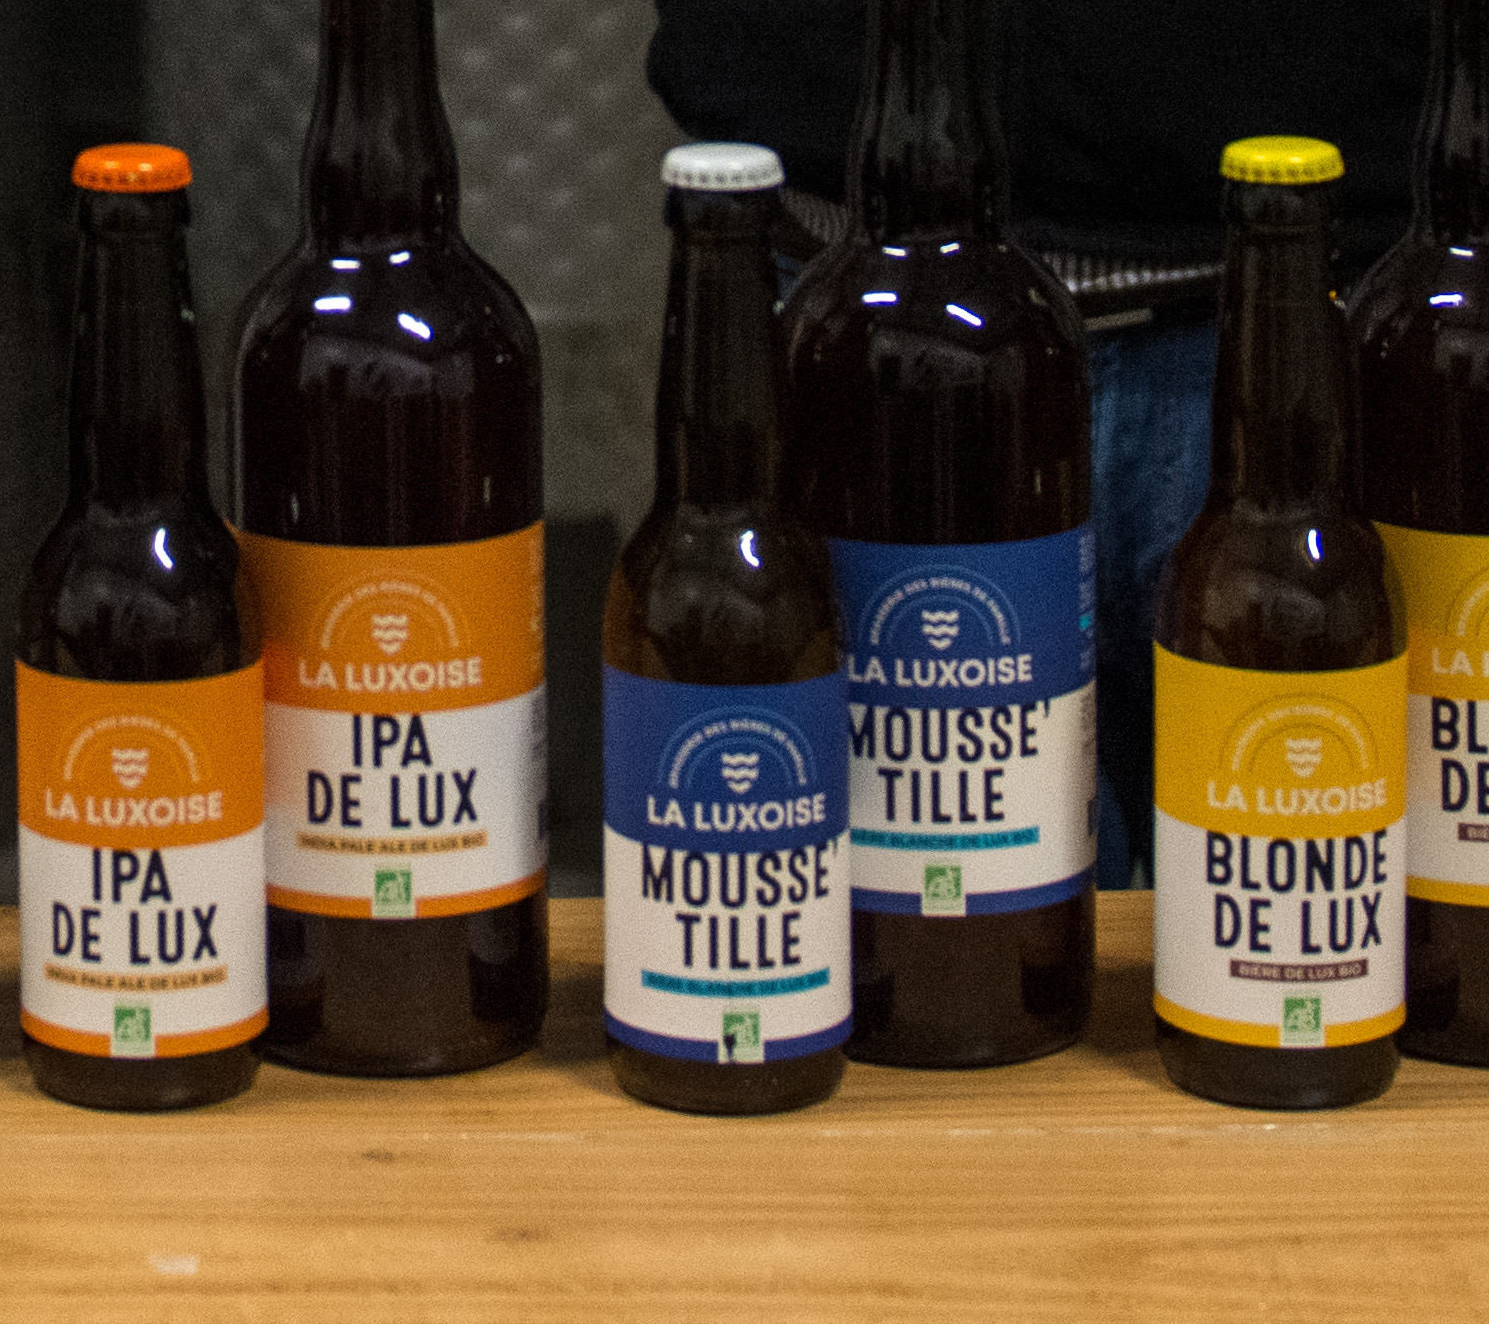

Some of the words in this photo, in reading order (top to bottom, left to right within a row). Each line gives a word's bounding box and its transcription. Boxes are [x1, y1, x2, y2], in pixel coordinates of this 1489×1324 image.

[299, 658, 337, 689] LA
[345, 656, 482, 692] LUXOISE
[848, 655, 887, 686] LA
[895, 654, 1033, 687] LUXOISE
[1432, 648, 1474, 675] LA
[352, 713, 432, 768] IPA
[45, 788, 79, 822] LA
[85, 791, 223, 827] LUXOISE
[307, 770, 362, 828] DE
[390, 768, 477, 829] LUX
[647, 795, 685, 828] LA
[694, 793, 826, 832] LUXOISE
[878, 768, 1005, 824] TILLE
[1207, 780, 1247, 812] LA
[1256, 778, 1387, 816] LUXOISE
[93, 847, 172, 904] IPA
[1206, 829, 1387, 893] BLONDE
[53, 901, 101, 962] DE
[130, 903, 217, 965] LUX
[675, 911, 801, 970] TILLE
[1214, 892, 1272, 953] DE
[1301, 891, 1382, 955] LUX
